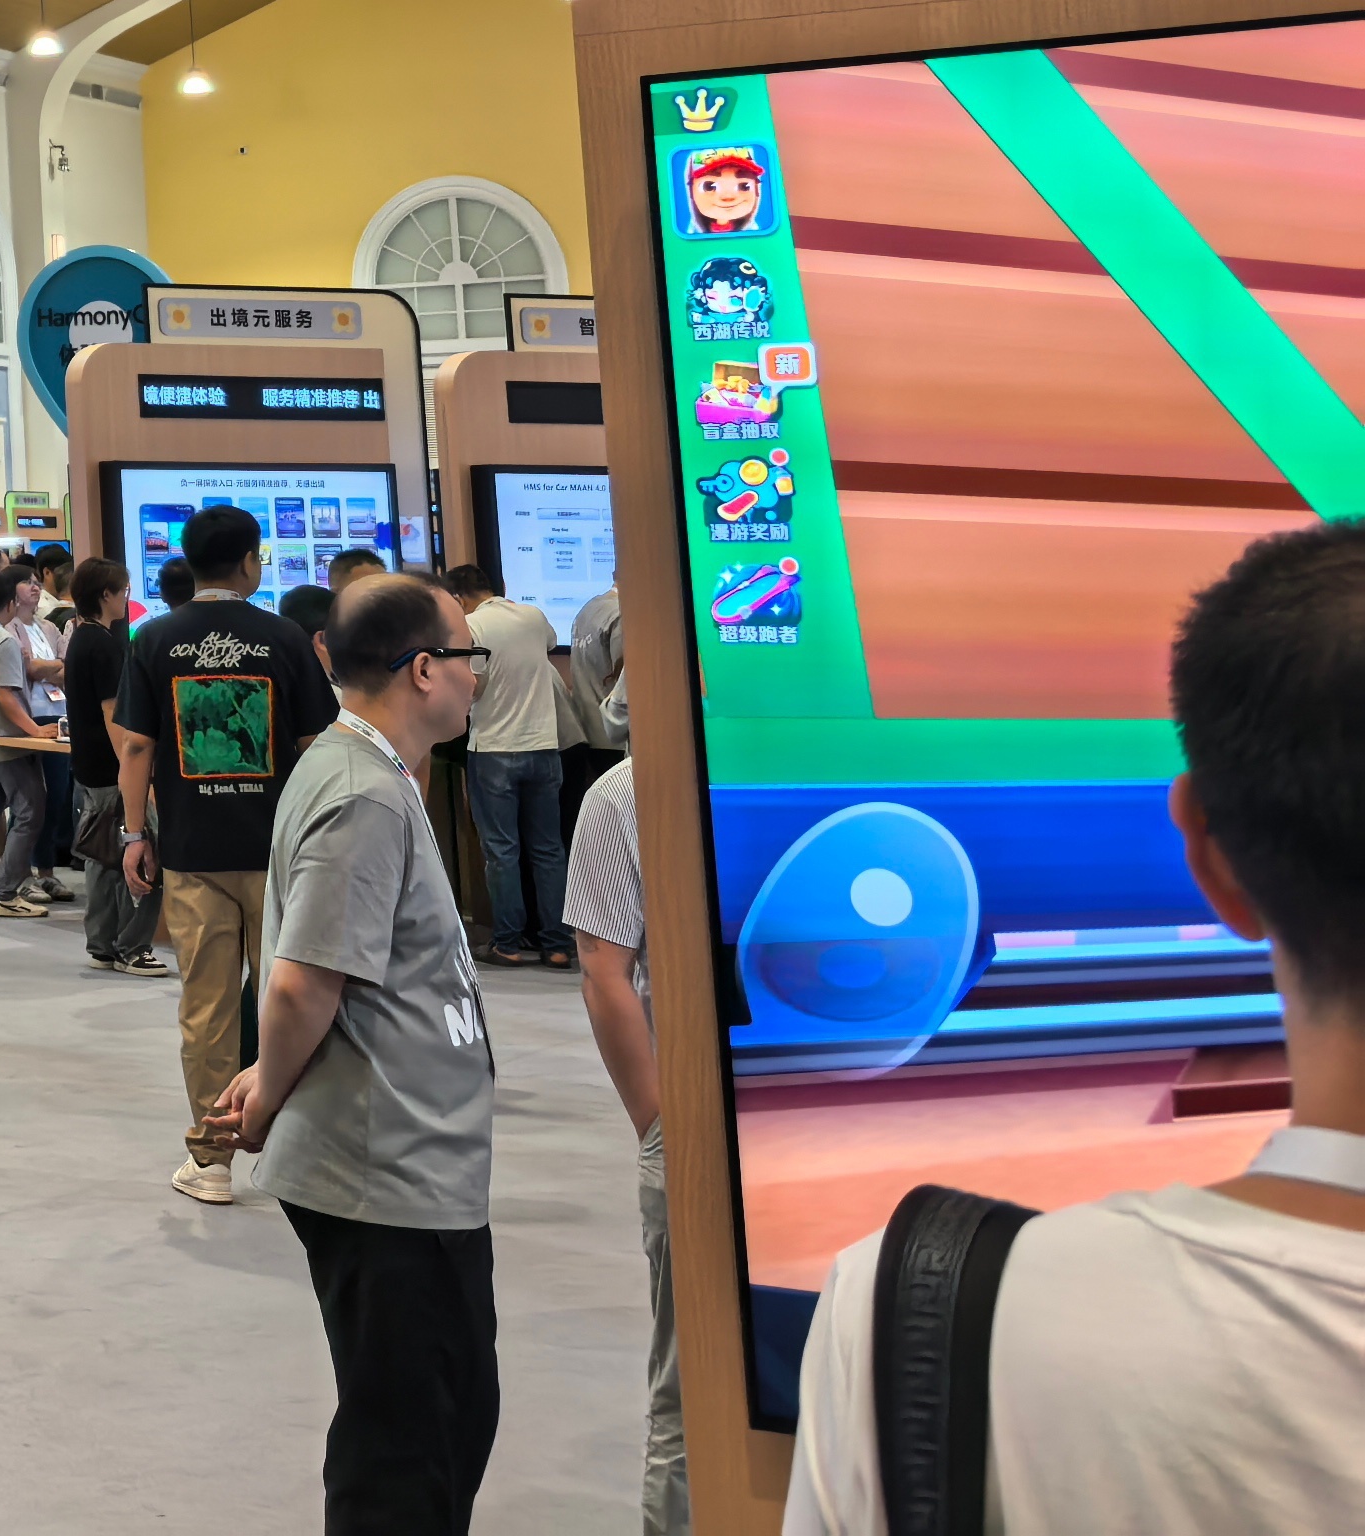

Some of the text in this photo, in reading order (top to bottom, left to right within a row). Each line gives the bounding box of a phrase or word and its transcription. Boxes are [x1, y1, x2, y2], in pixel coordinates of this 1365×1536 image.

[209, 307, 314, 329] 出境元服务
[692, 321, 771, 341] 西湖传说
[774, 353, 801, 375] 新
[261, 387, 360, 409] 服务精准推荐
[700, 422, 780, 440] 盲盒抽取
[709, 522, 790, 542] 漫游奖励
[718, 625, 799, 644] 超级跑者
